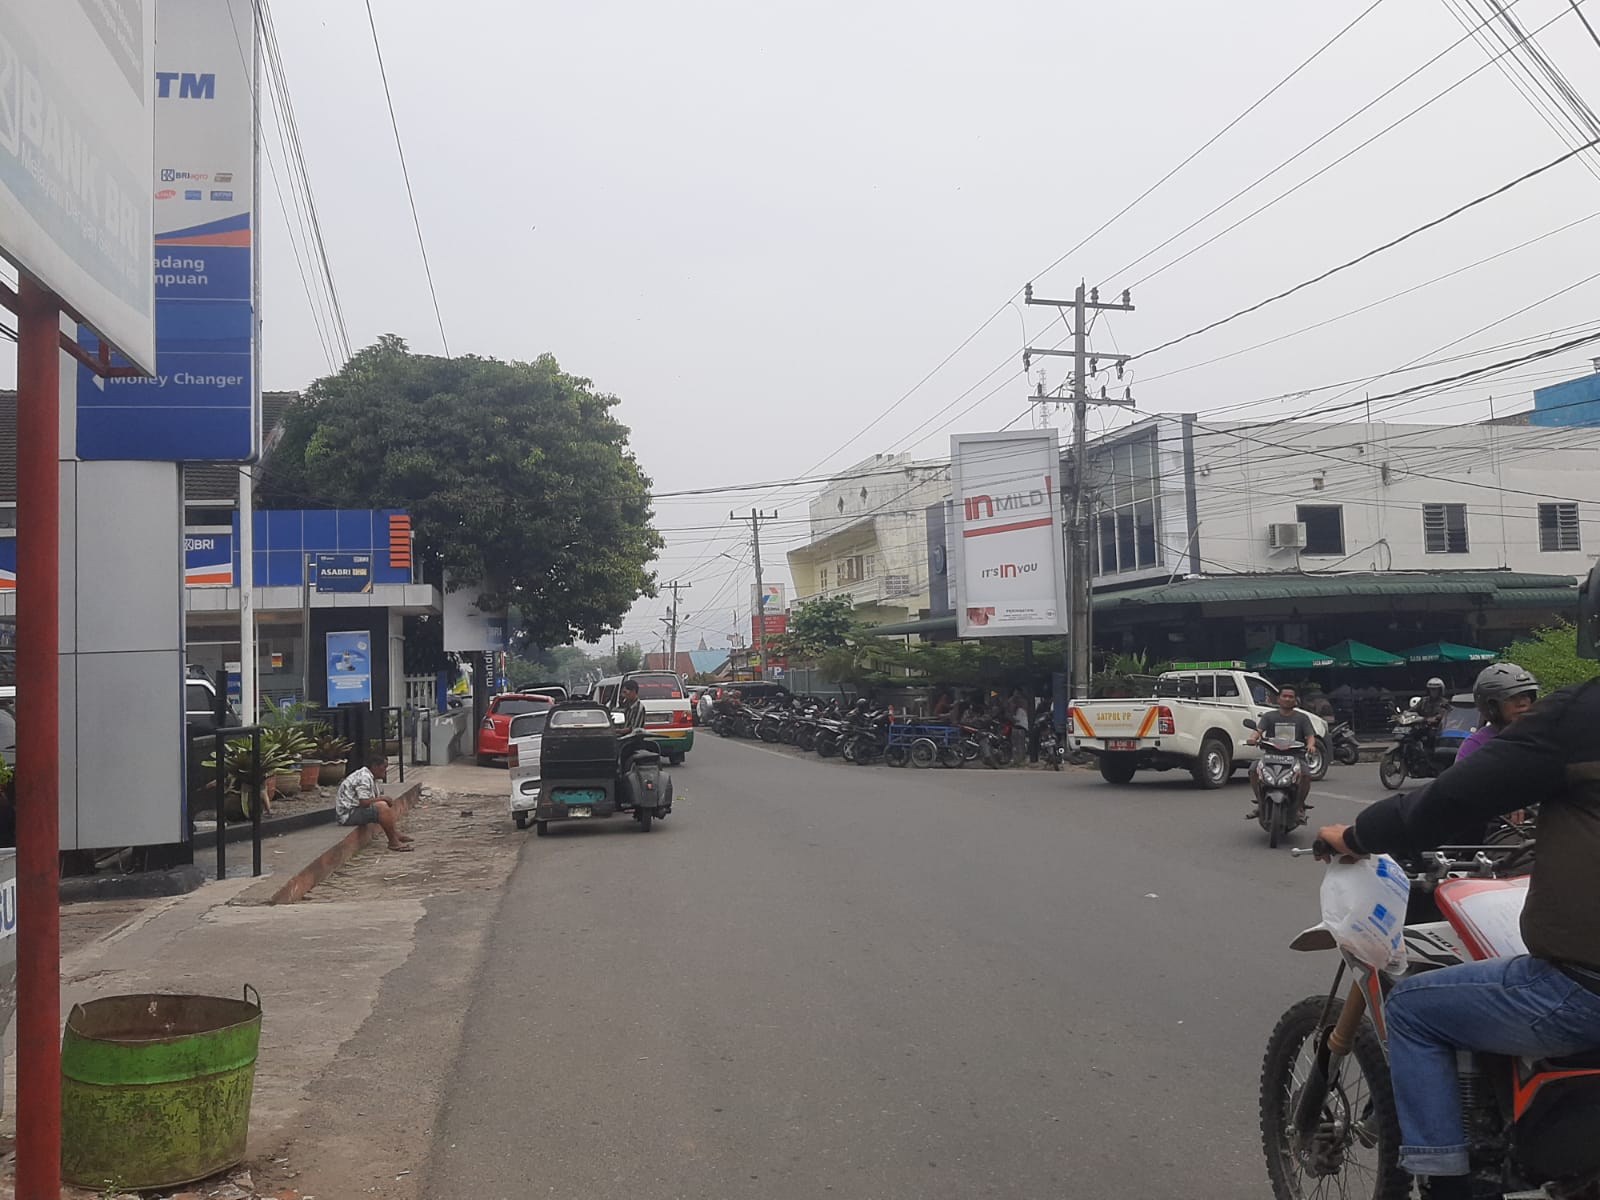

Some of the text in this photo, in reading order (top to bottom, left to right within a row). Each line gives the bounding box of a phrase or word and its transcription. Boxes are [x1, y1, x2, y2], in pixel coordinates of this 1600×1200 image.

[156, 72, 215, 99] TM
[22, 62, 99, 217] BANK
[104, 171, 140, 263] BRI
[174, 373, 244, 388] Changer
[194, 539, 214, 550] BRI
[320, 568, 351, 576] ASABRI
[982, 567, 999, 578] IT'S
[1017, 563, 1038, 574] YOU
